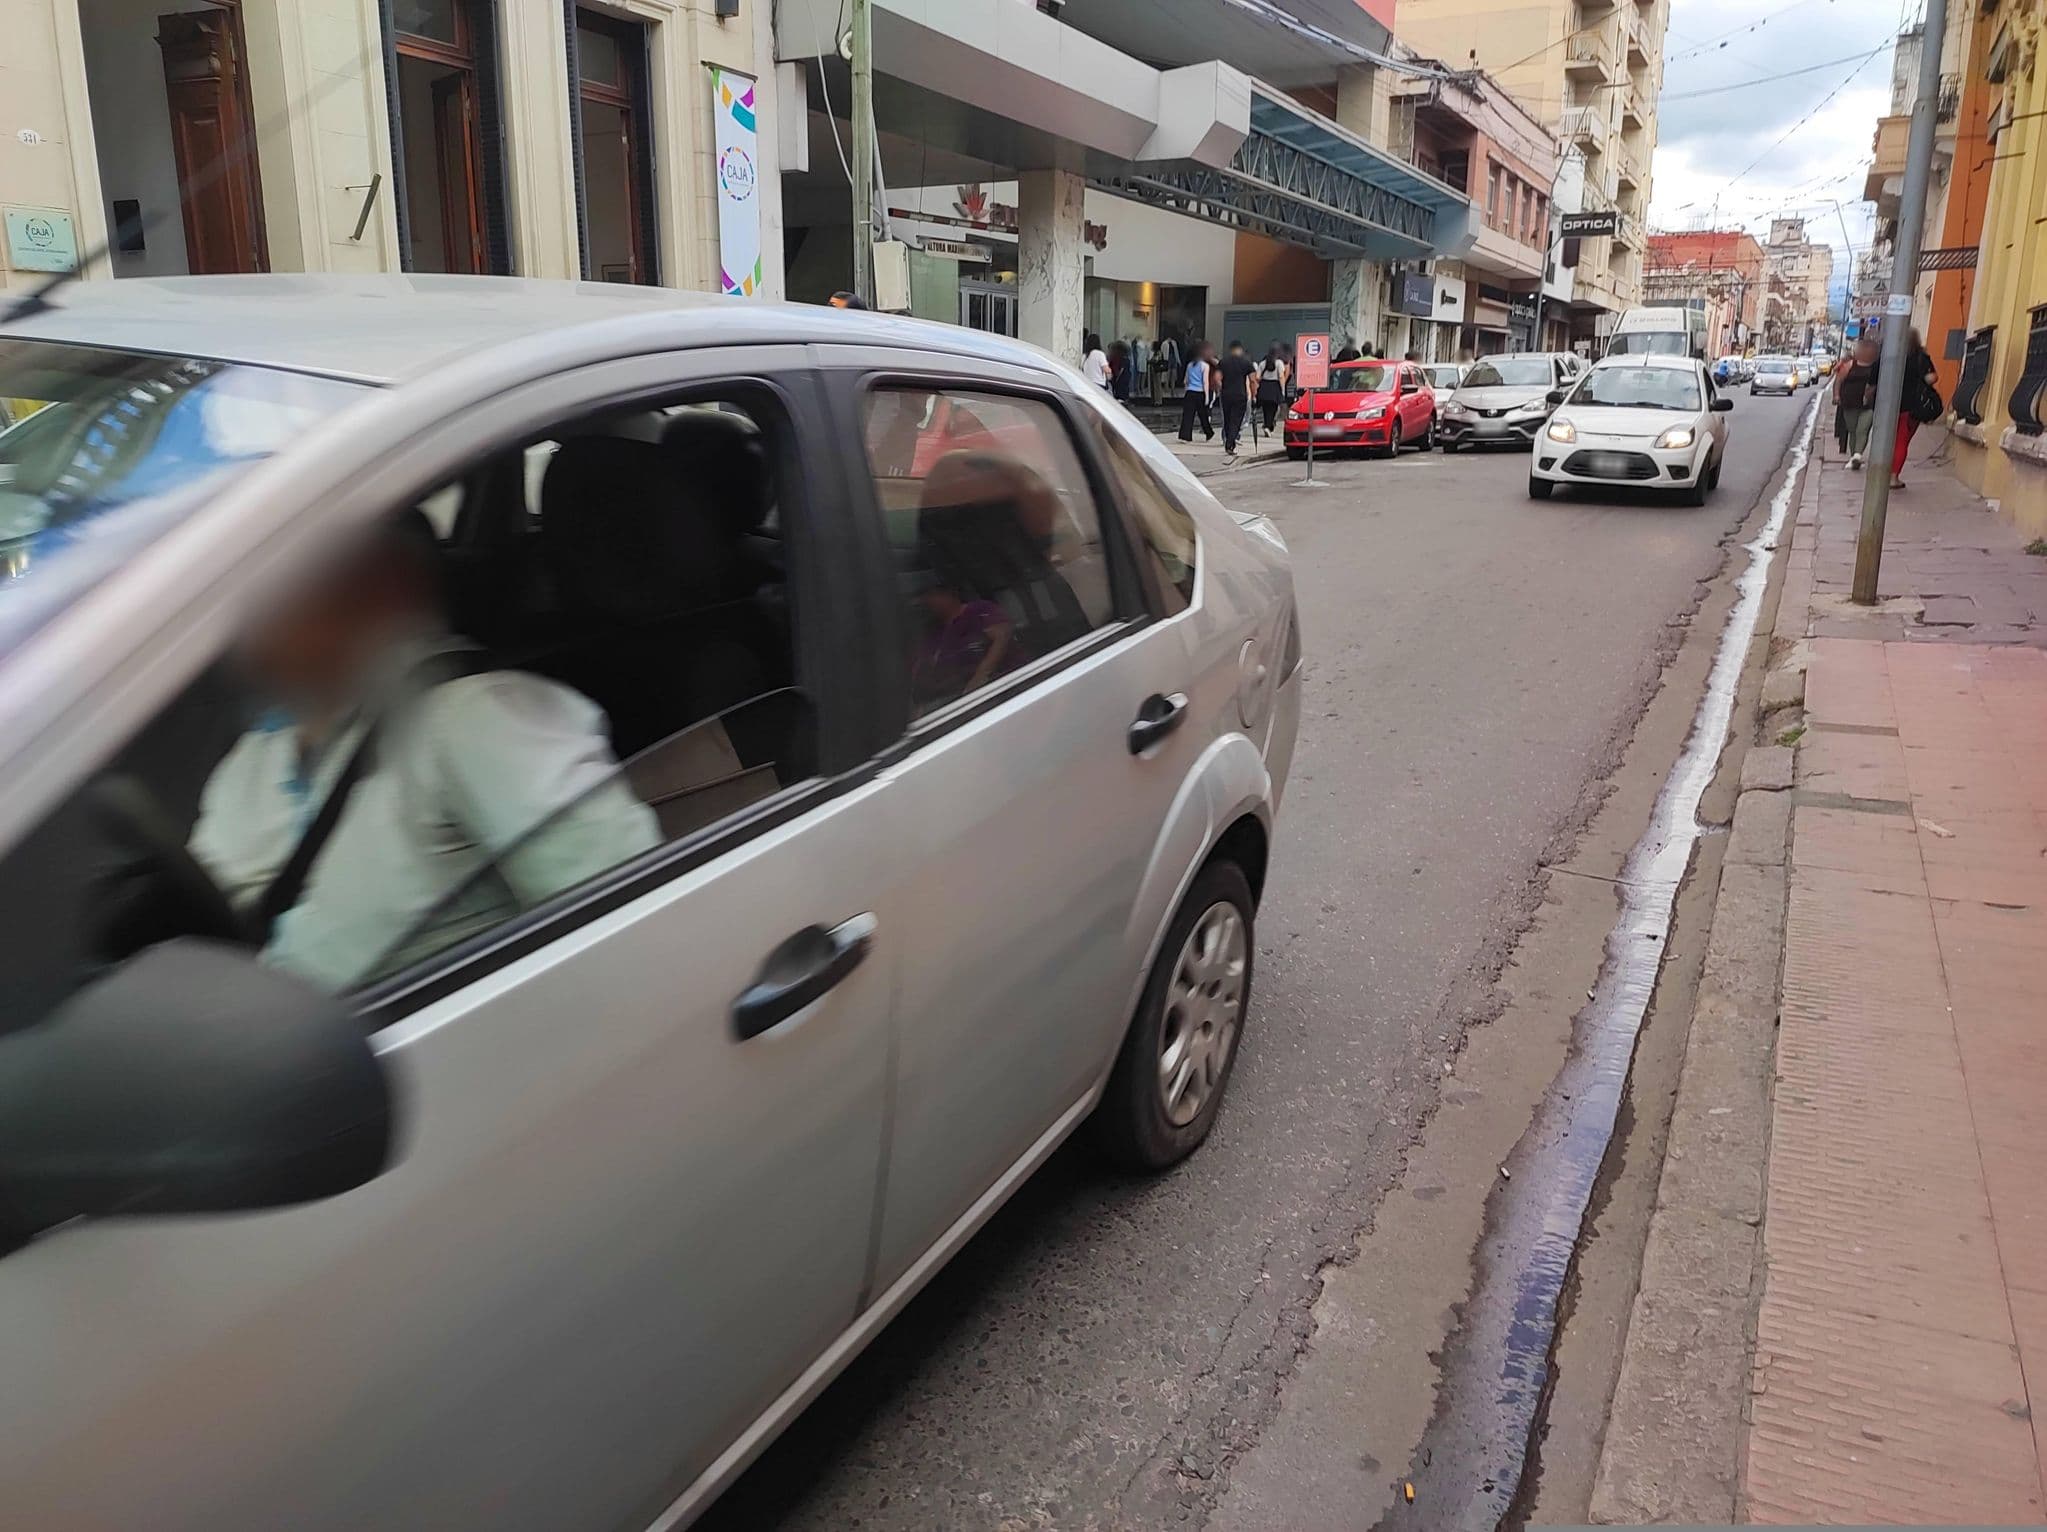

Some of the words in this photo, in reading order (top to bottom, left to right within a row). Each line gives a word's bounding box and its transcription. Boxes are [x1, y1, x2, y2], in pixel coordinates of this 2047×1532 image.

[727, 164, 749, 182] CAJA
[1562, 218, 1614, 231] OPTICA
[31, 227, 50, 237] CAJA
[1308, 341, 1319, 355] E
